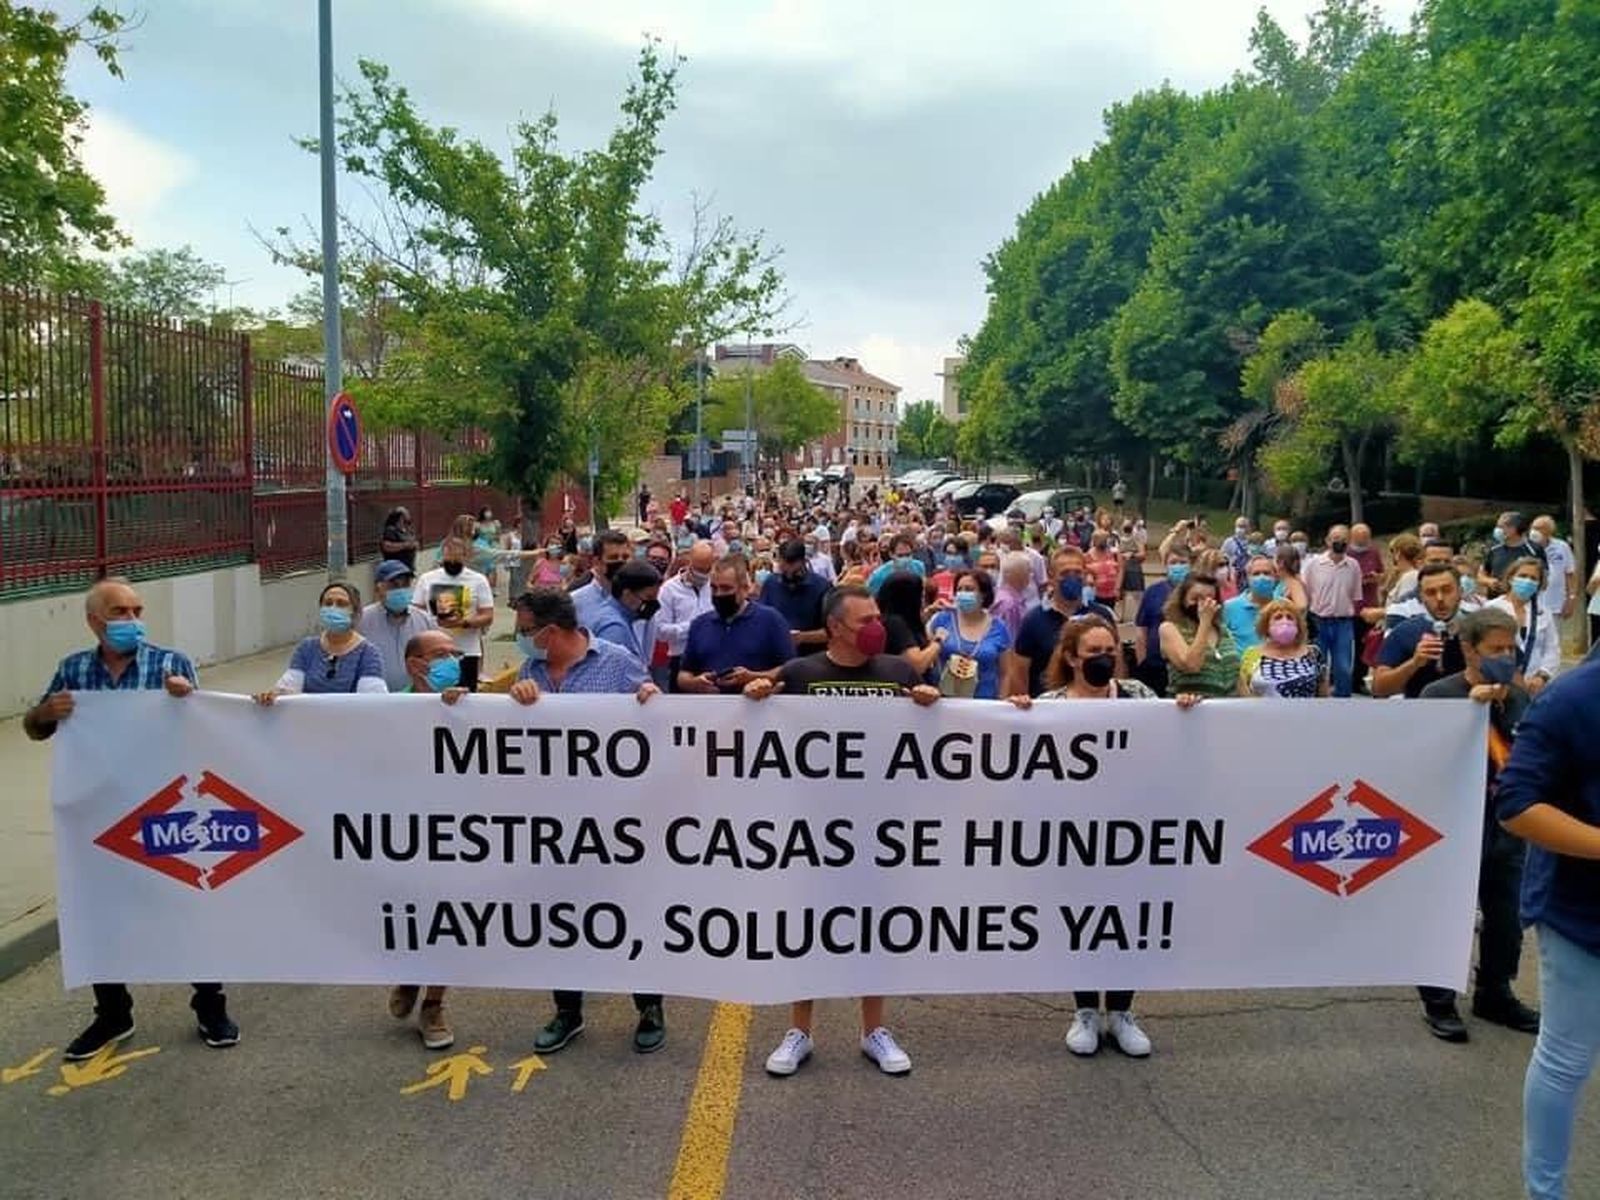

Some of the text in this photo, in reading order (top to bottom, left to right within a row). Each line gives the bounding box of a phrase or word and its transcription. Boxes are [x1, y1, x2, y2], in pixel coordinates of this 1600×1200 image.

[433, 726, 1129, 782] METRO "HACE AGUAS"
[333, 812, 1225, 871] NUESTRAS CASAS SE HUNDEN
[381, 900, 1174, 961] ¡¡AYUSO, SOLUCIONES YA!!
